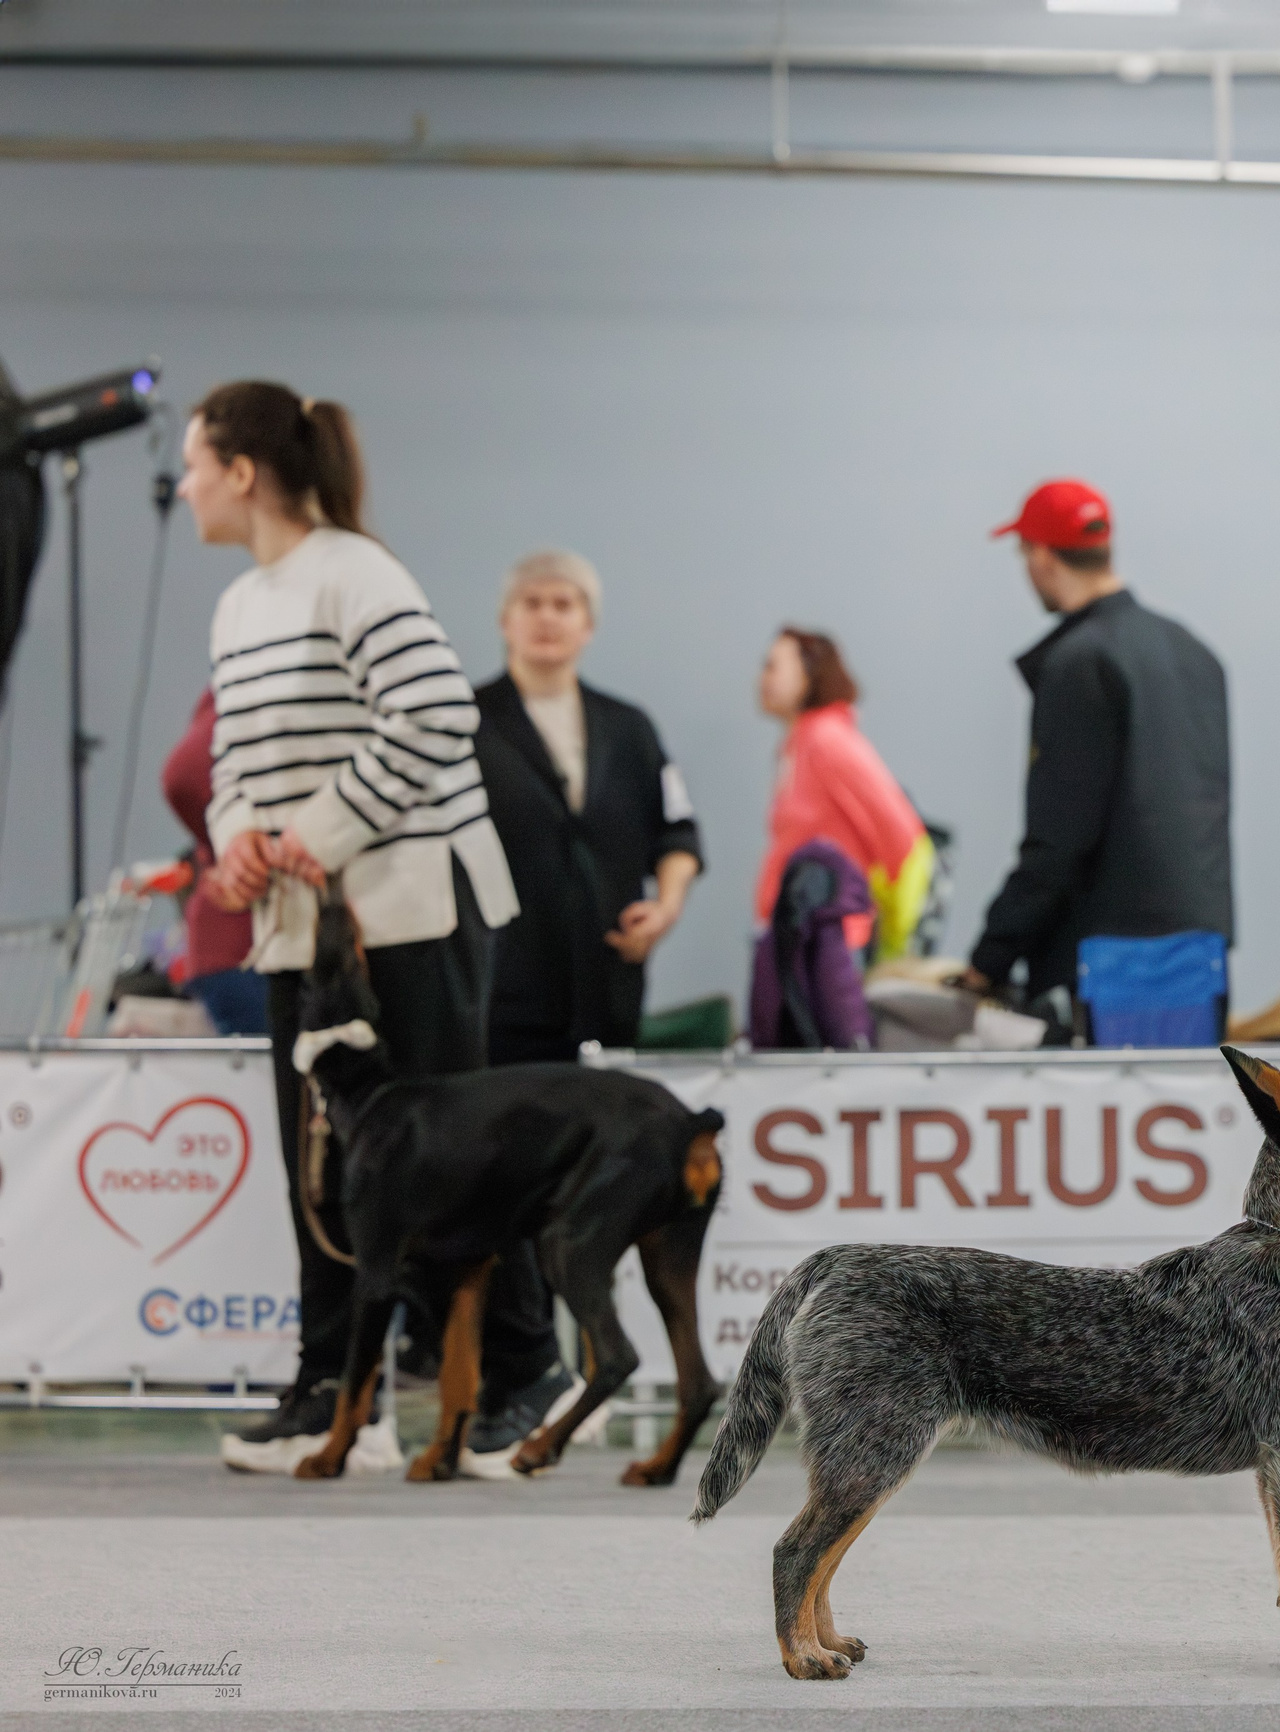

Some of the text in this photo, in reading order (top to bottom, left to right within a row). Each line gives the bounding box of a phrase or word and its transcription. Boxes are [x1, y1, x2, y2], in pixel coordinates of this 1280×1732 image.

[178, 1134, 232, 1156] ЭТО
[753, 1105, 1208, 1212] SIRIUS
[100, 1170, 218, 1192] ЛЮБОВЬ
